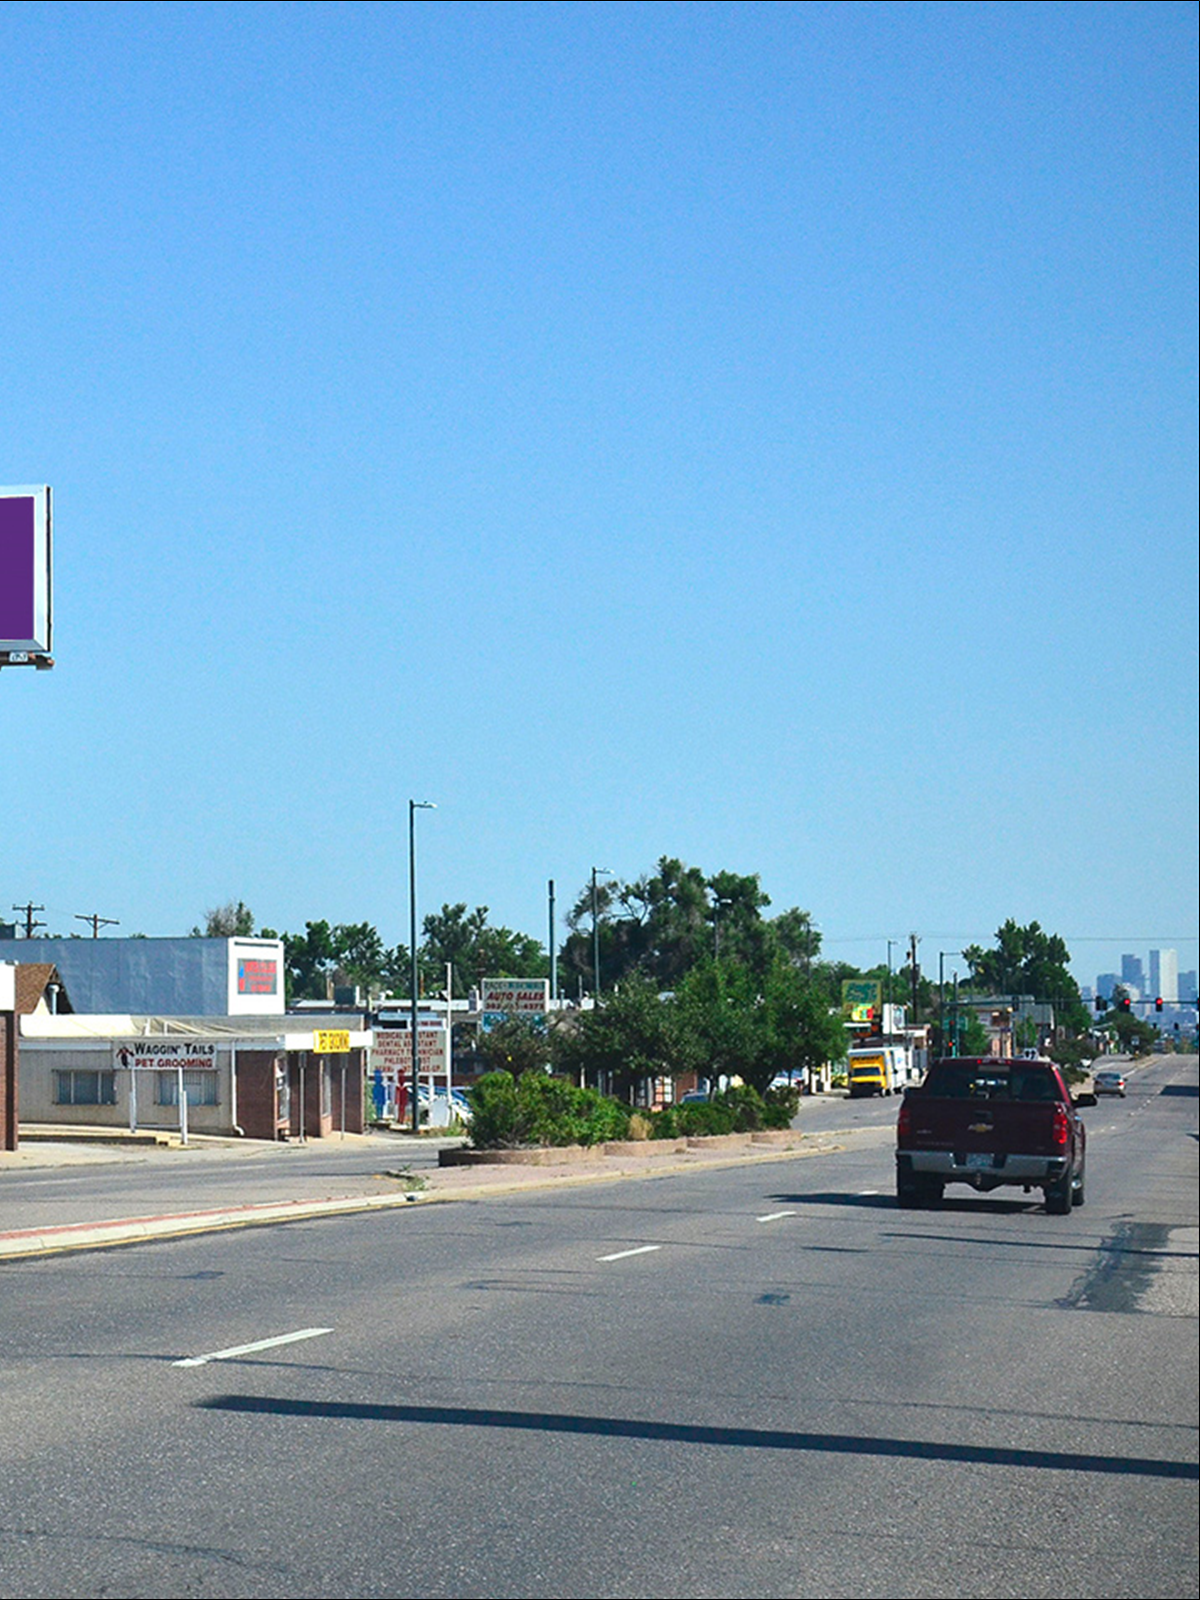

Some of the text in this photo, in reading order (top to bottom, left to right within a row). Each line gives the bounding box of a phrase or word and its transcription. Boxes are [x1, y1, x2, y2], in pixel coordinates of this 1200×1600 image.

[184, 1043, 215, 1055] TAILS
[135, 1058, 213, 1068] PET GROOMING
